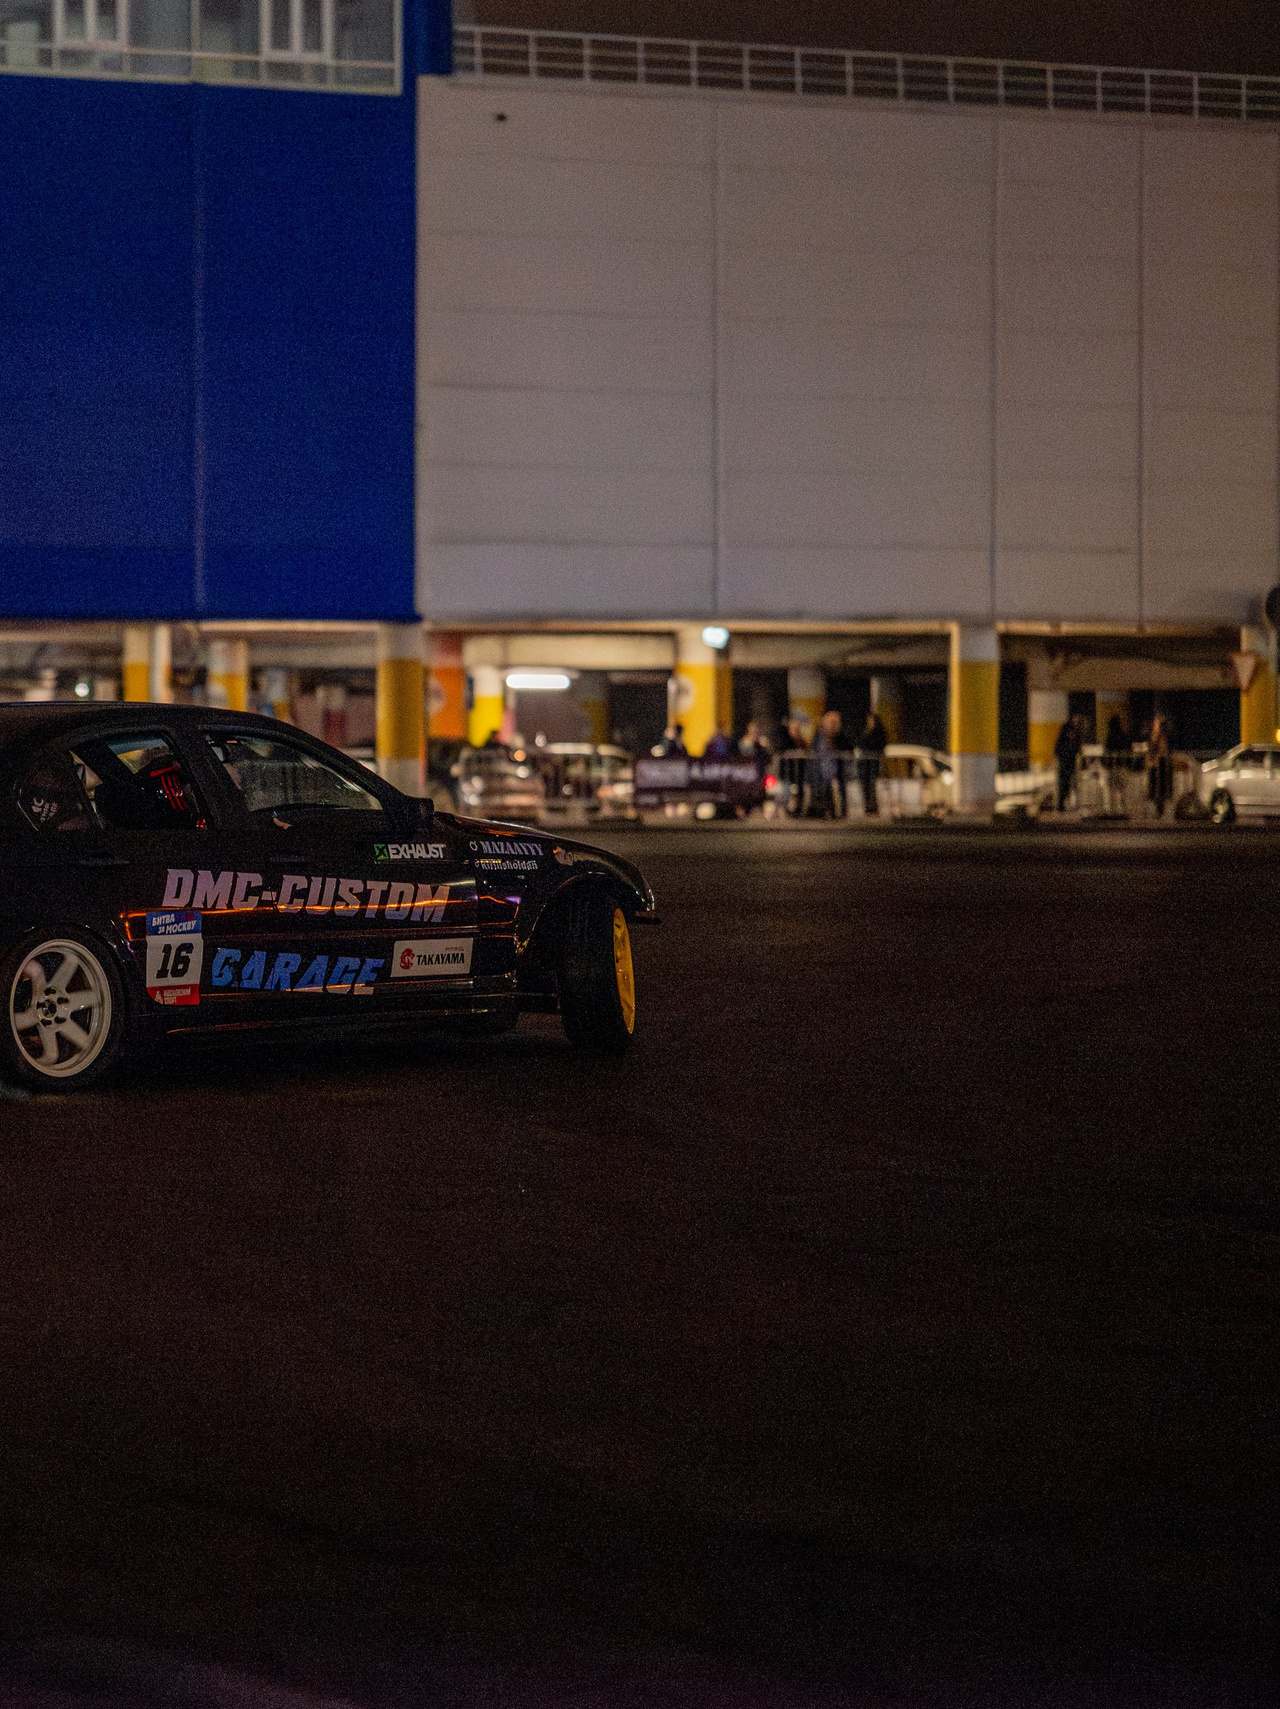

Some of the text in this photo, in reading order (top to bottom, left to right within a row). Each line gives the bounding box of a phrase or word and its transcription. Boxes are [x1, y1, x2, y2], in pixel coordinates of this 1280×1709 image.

[387, 843, 447, 860] EXHAUST
[161, 868, 451, 922] DMC-CUSTOM
[156, 942, 194, 979] 16
[211, 947, 385, 995] GARAGE
[416, 953, 466, 966] TAKAYAMA
